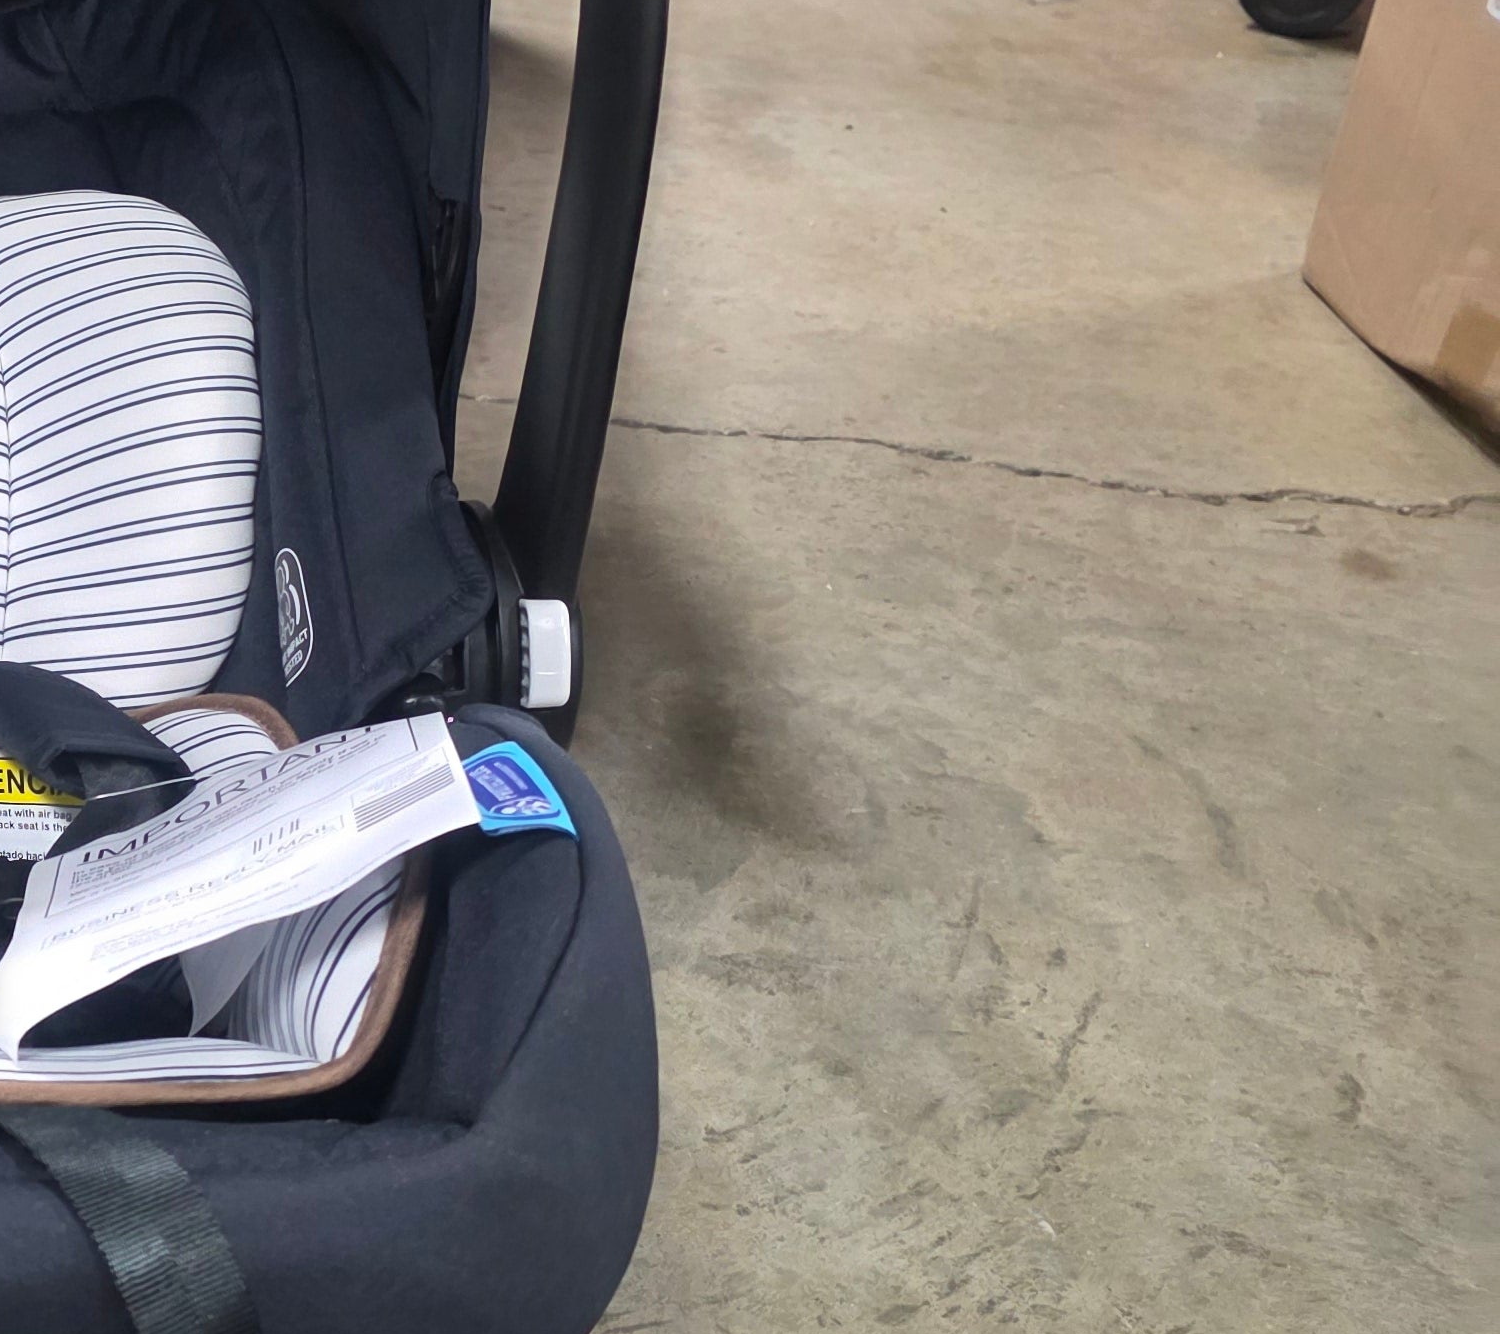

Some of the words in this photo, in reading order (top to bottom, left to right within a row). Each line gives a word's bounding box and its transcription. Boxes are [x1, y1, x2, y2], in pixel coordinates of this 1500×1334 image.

[83, 726, 371, 863] IMPORTAN
[14, 808, 35, 818] with
[38, 809, 51, 819] air
[18, 821, 39, 831] seat
[42, 822, 50, 831] is
